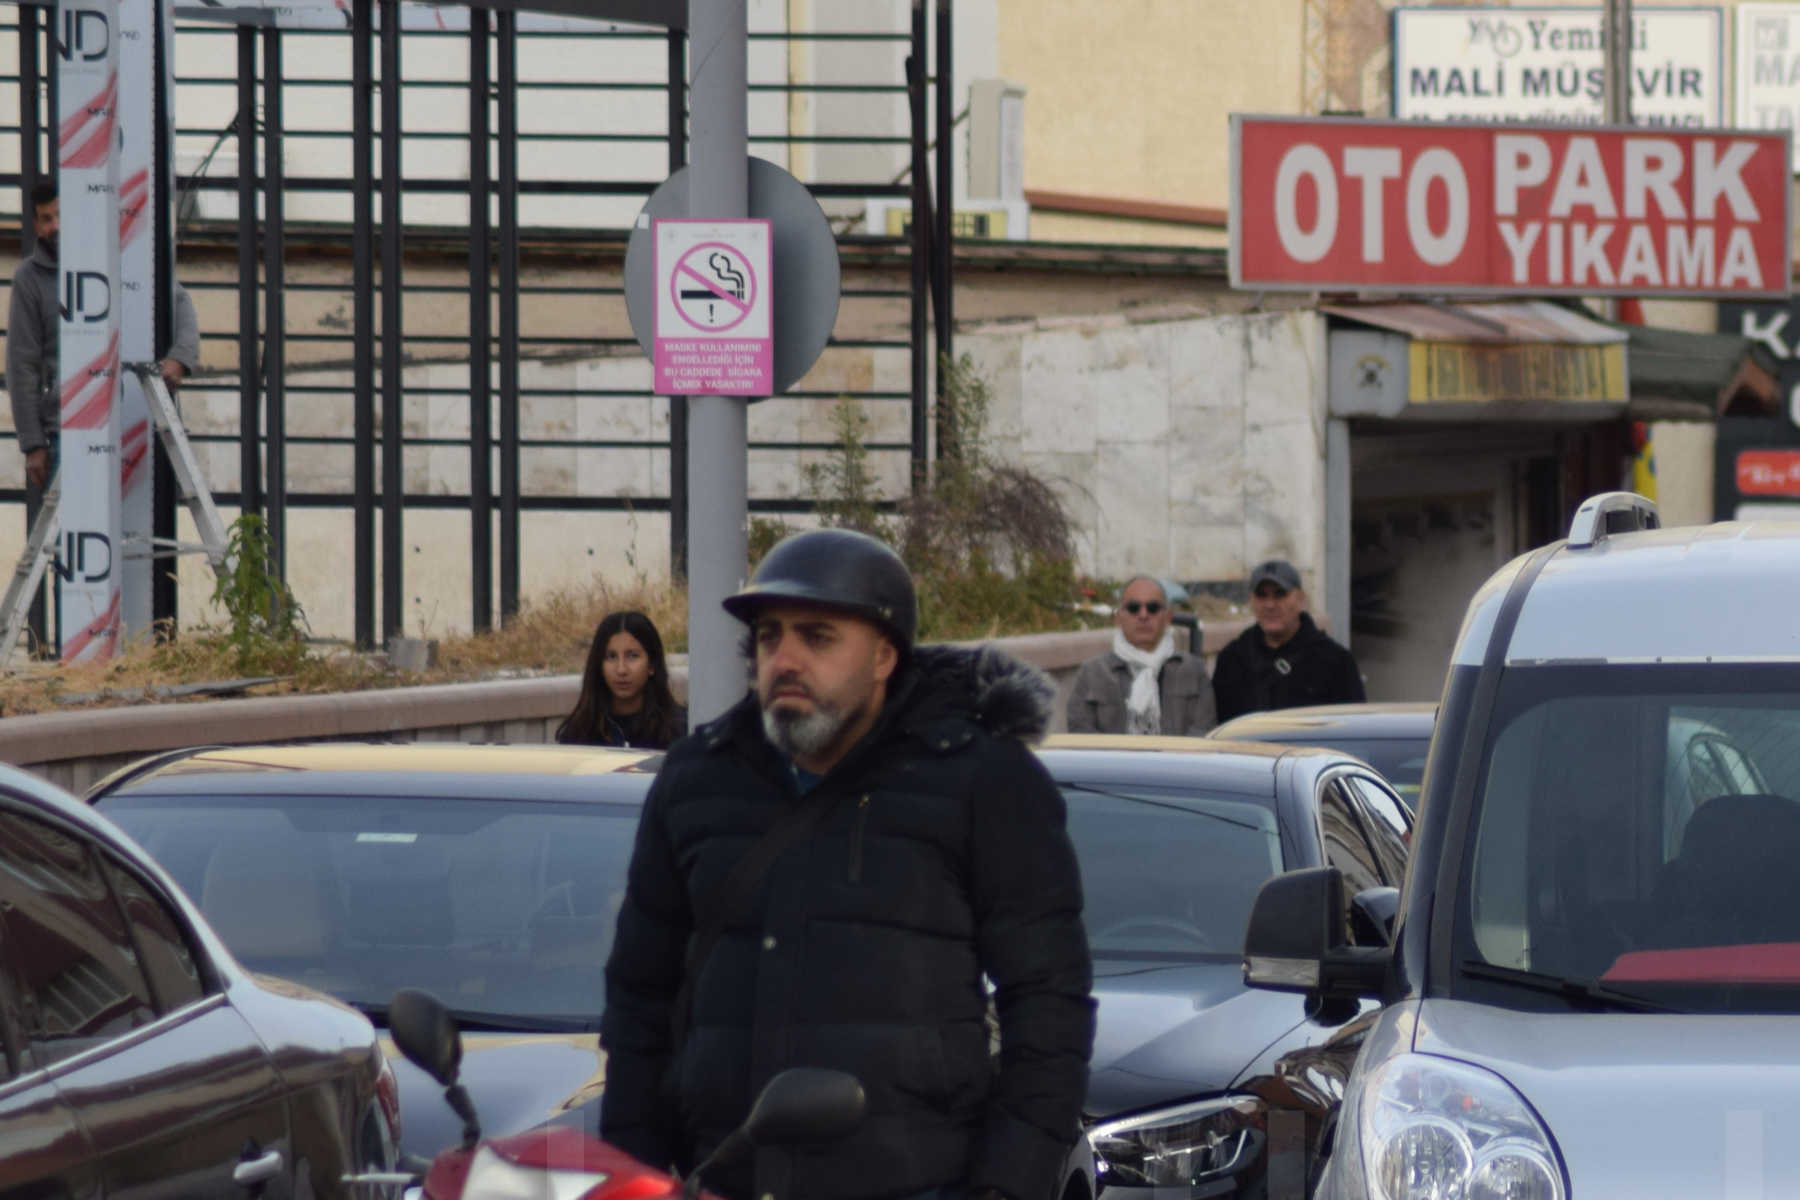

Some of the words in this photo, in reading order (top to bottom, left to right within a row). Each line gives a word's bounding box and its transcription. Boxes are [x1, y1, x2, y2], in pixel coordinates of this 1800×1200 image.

[1410, 60, 1505, 98] MALİ
[1521, 58, 1703, 104] MÜŞVİR
[1274, 143, 1470, 266] OTO
[1494, 133, 1761, 222] PARK
[1497, 220, 1763, 288] YIKAMA
